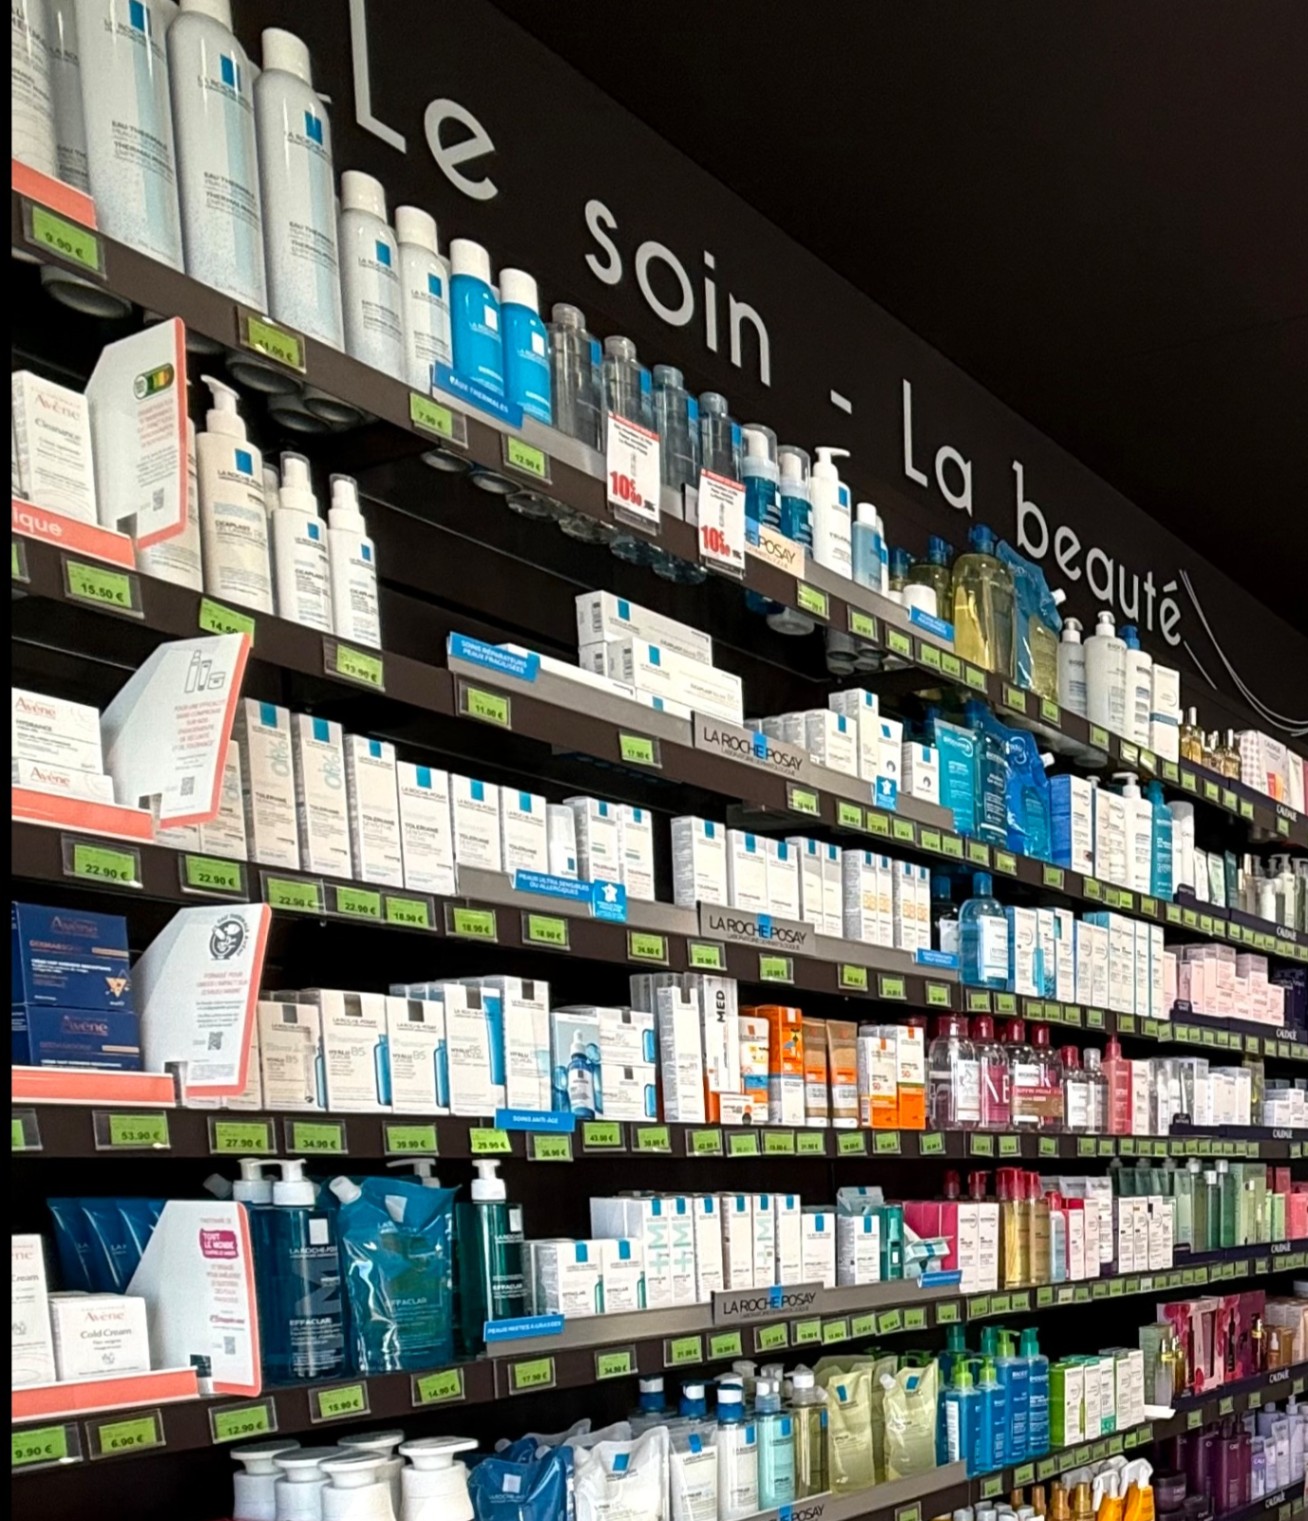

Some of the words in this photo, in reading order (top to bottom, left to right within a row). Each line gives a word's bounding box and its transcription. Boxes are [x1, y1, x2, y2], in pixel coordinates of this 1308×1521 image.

[349, 0, 499, 200] Le
[584, 199, 770, 387] soin
[903, 378, 973, 518] La
[1013, 461, 1182, 646] beauté
[759, 535, 796, 565] POSAY
[80, 582, 113, 598] 15.50
[703, 727, 720, 745] LA
[85, 863, 117, 879] 22.90
[199, 872, 226, 886] 22.90
[345, 901, 367, 914] 22.90
[709, 915, 726, 931] LA
[715, 989, 727, 1023] MED
[121, 1130, 150, 1141] 53.90
[225, 1138, 254, 1148] 27.90
[723, 1299, 740, 1315] LA
[79, 1330, 103, 1340] Cold
[103, 1327, 132, 1338] Cream
[227, 1423, 254, 1435] 12.90
[111, 1436, 135, 1448] 6.90
[14, 1446, 42, 1458] 9.90
